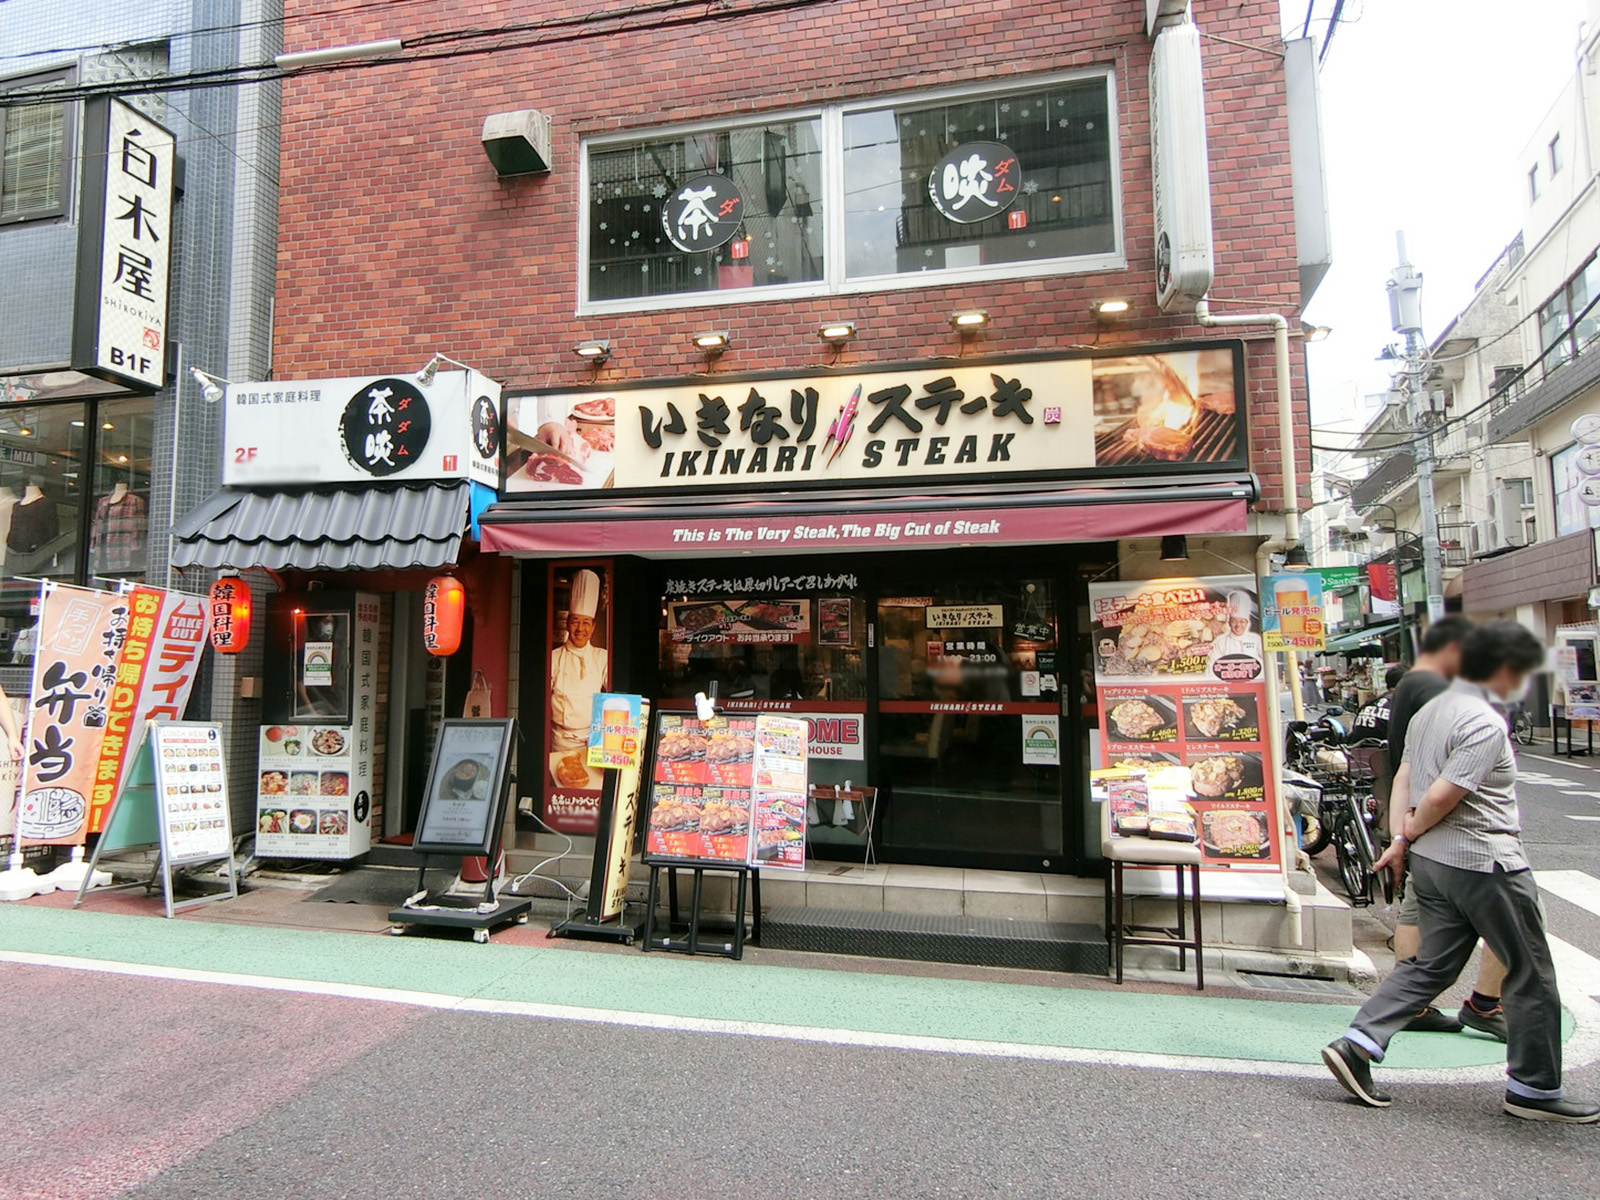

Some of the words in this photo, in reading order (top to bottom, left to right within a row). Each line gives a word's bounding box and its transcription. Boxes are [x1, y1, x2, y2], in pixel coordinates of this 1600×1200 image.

[112, 128, 160, 303] 白木屋
[110, 346, 151, 374] B1F
[236, 389, 322, 405] 韓国式家庭料理
[638, 386, 820, 449] いきなり
[867, 372, 1034, 434] ステーキ
[396, 397, 412, 456] ダダム
[235, 447, 258, 464] 2F
[660, 445, 817, 478] IKINARI
[861, 432, 1016, 468] STEAK
[672, 529, 704, 542] This
[707, 528, 721, 541] is
[725, 527, 753, 541] The
[757, 526, 790, 543] Very
[841, 524, 872, 538] The
[874, 523, 901, 540] Big
[904, 522, 930, 536] Cut
[934, 520, 951, 535] of
[953, 519, 1001, 534] Steak
[212, 583, 236, 646] 韓国料理
[1264, 606, 1320, 616] ビール発売中
[170, 617, 204, 630] TAKE
[170, 628, 199, 640] OUT
[1015, 623, 1050, 636] 営業中
[29, 661, 92, 783] 弁当
[592, 724, 638, 733] ビール発売中
[808, 746, 843, 755] HOUSE
[619, 792, 635, 877] ステーキ
